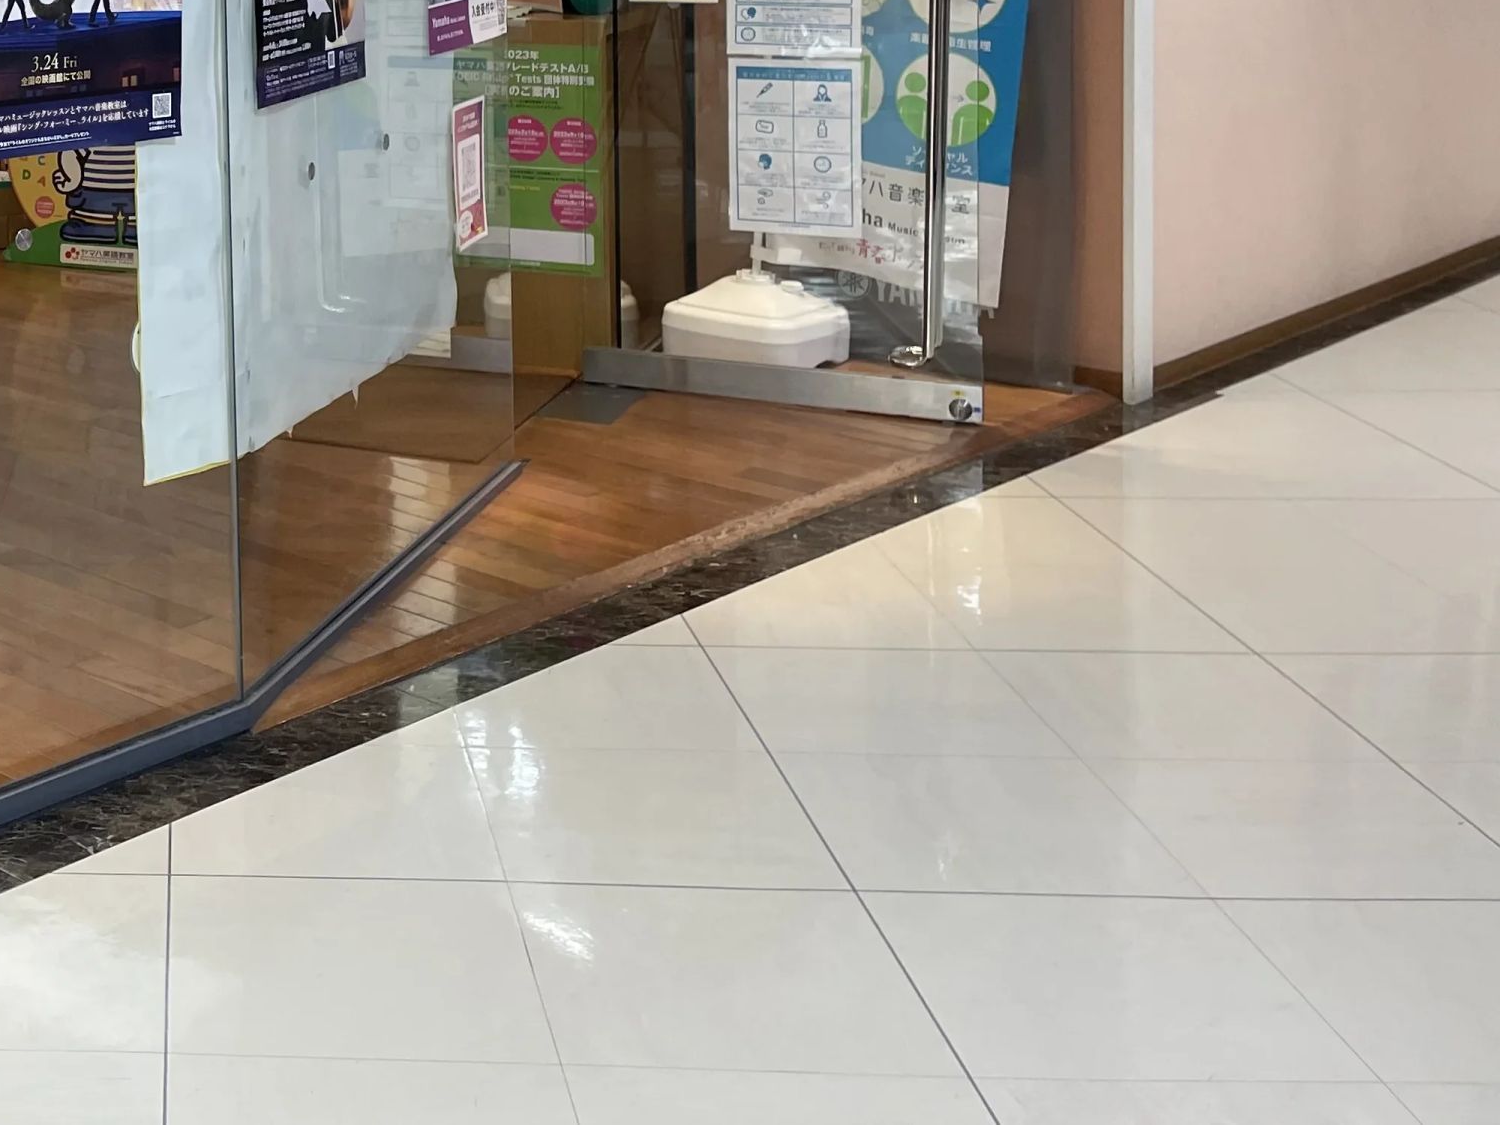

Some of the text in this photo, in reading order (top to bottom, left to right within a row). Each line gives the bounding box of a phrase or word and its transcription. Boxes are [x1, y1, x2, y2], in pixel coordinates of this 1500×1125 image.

[31, 52, 78, 73] 3.24 Fri
[22, 169, 32, 180] D
[888, 222, 920, 237] Music
